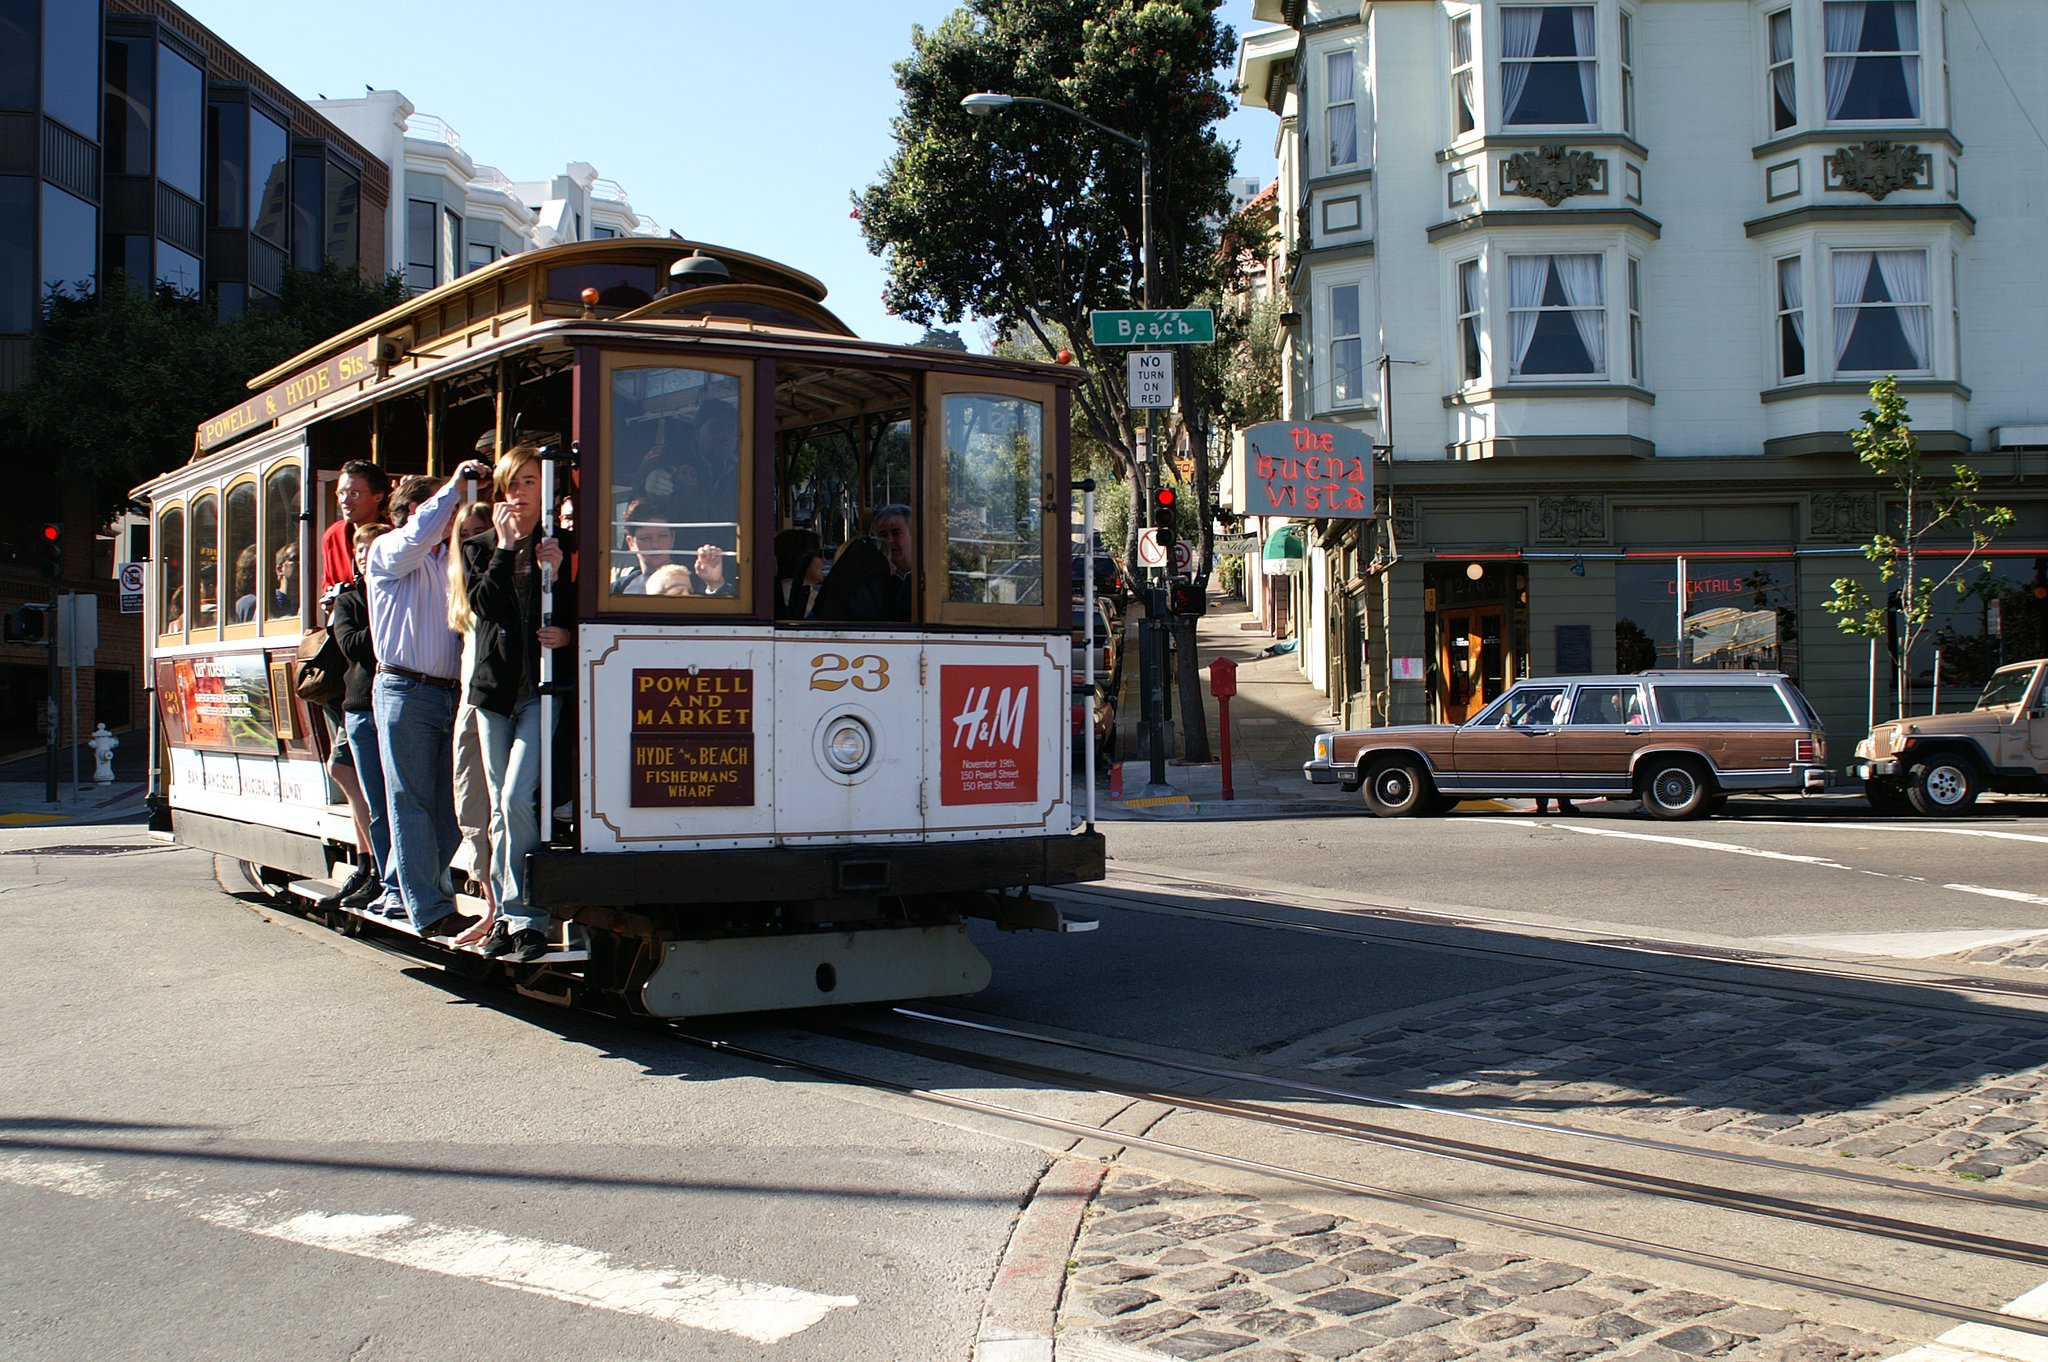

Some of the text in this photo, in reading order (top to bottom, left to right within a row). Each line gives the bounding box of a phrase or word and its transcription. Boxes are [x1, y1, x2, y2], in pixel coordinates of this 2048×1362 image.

[1118, 319, 1191, 337] Beach
[1140, 356, 1160, 367] NO
[1138, 371, 1164, 380] TURN
[1143, 382, 1159, 391] ON
[206, 355, 368, 443] POWELL & HYDE Sts.
[1141, 394, 1161, 403] RED
[1668, 578, 1743, 595] CCKTAILS
[809, 653, 890, 692] 23
[638, 676, 748, 693] POWELL
[668, 695, 723, 707] AND
[637, 709, 750, 725] MARKET
[952, 686, 1028, 750] H&M
[636, 747, 748, 765] HYDE AND BEACH
[962, 759, 1016, 769] November 19th.
[646, 770, 738, 783] FISHERMANS
[961, 769, 1019, 780] 150 Powell Street
[202, 771, 234, 791] ANCISCO
[273, 780, 302, 800] RILWAY
[668, 785, 716, 798] WHARF
[963, 782, 976, 791] 150
[977, 781, 993, 790] Post
